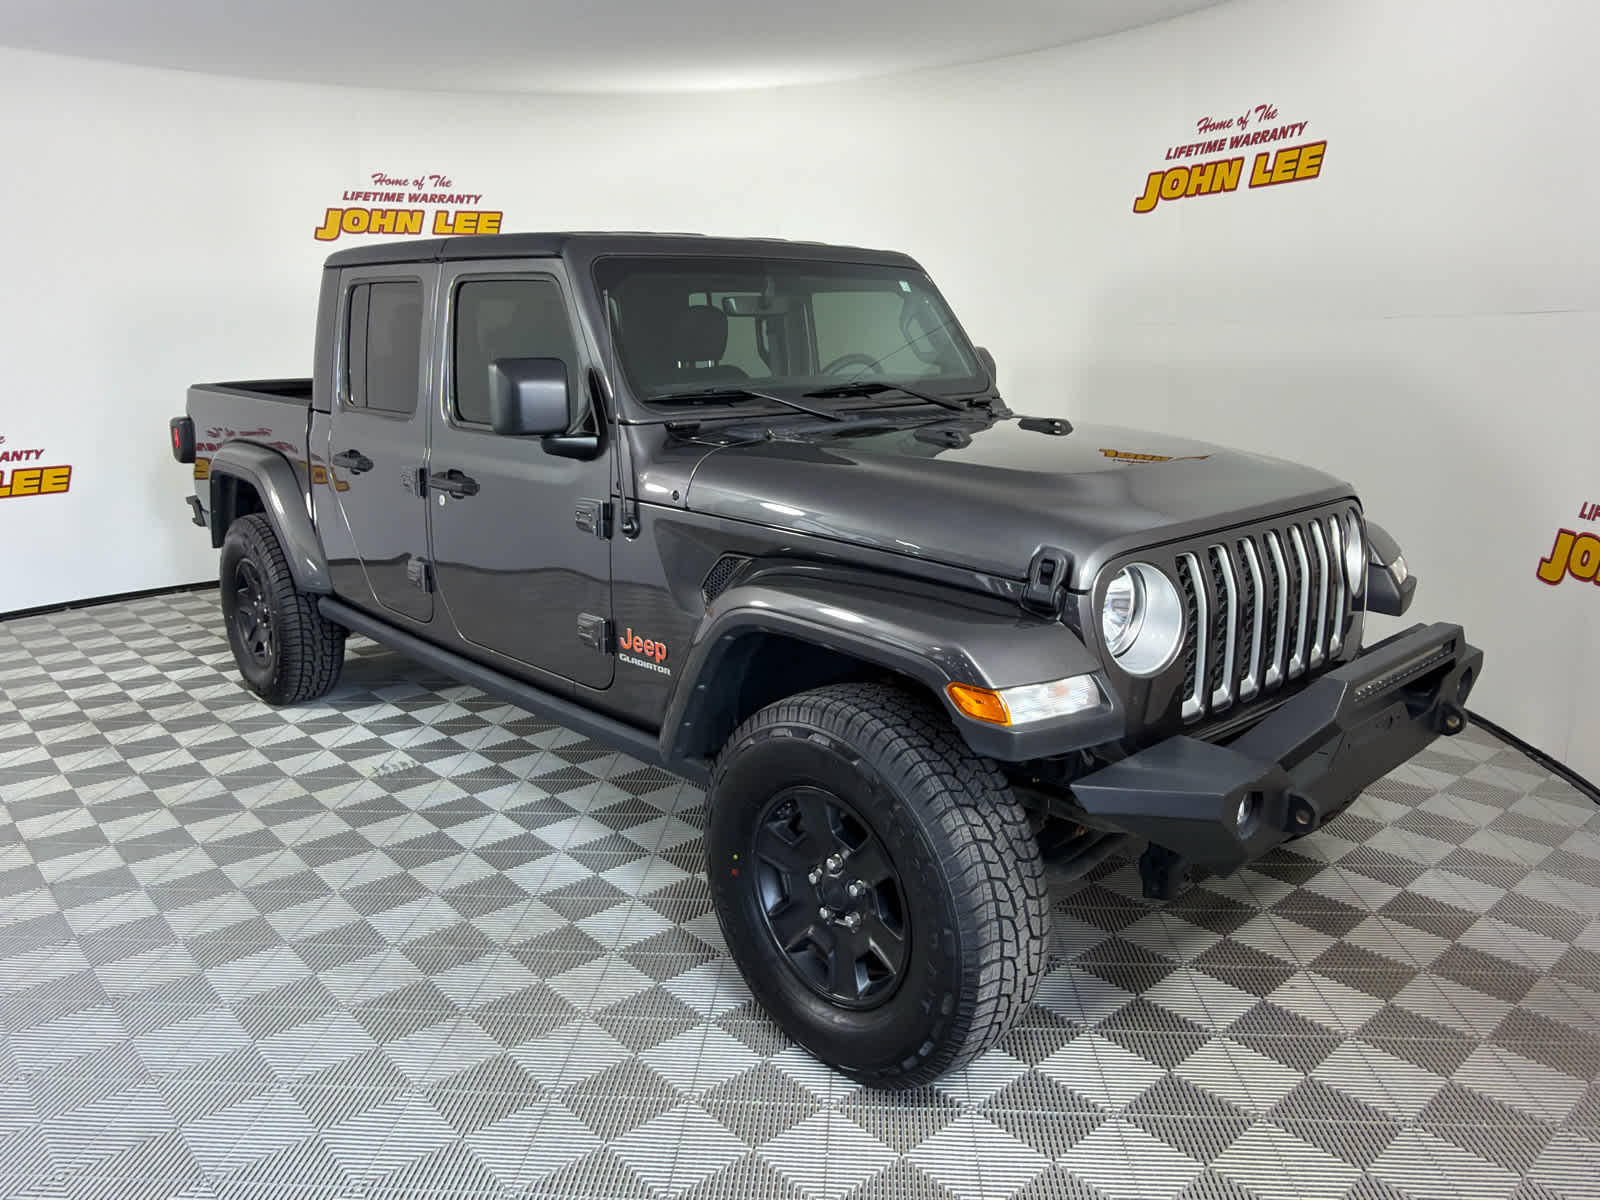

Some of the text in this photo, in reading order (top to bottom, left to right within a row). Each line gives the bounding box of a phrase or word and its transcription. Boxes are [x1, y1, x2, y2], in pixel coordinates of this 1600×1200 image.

[1196, 104, 1278, 134] Home of The
[1165, 121, 1309, 160] LIFETIME WARRANTY
[371, 172, 453, 190] Home of The
[1133, 140, 1327, 213] JOHN LEE
[342, 190, 482, 205] LIFETIME WARRANTY
[314, 207, 503, 241] JOHN LEE
[1536, 528, 1600, 587] JO
[619, 627, 667, 664] Jeep
[619, 653, 671, 676] GLADIATOR
